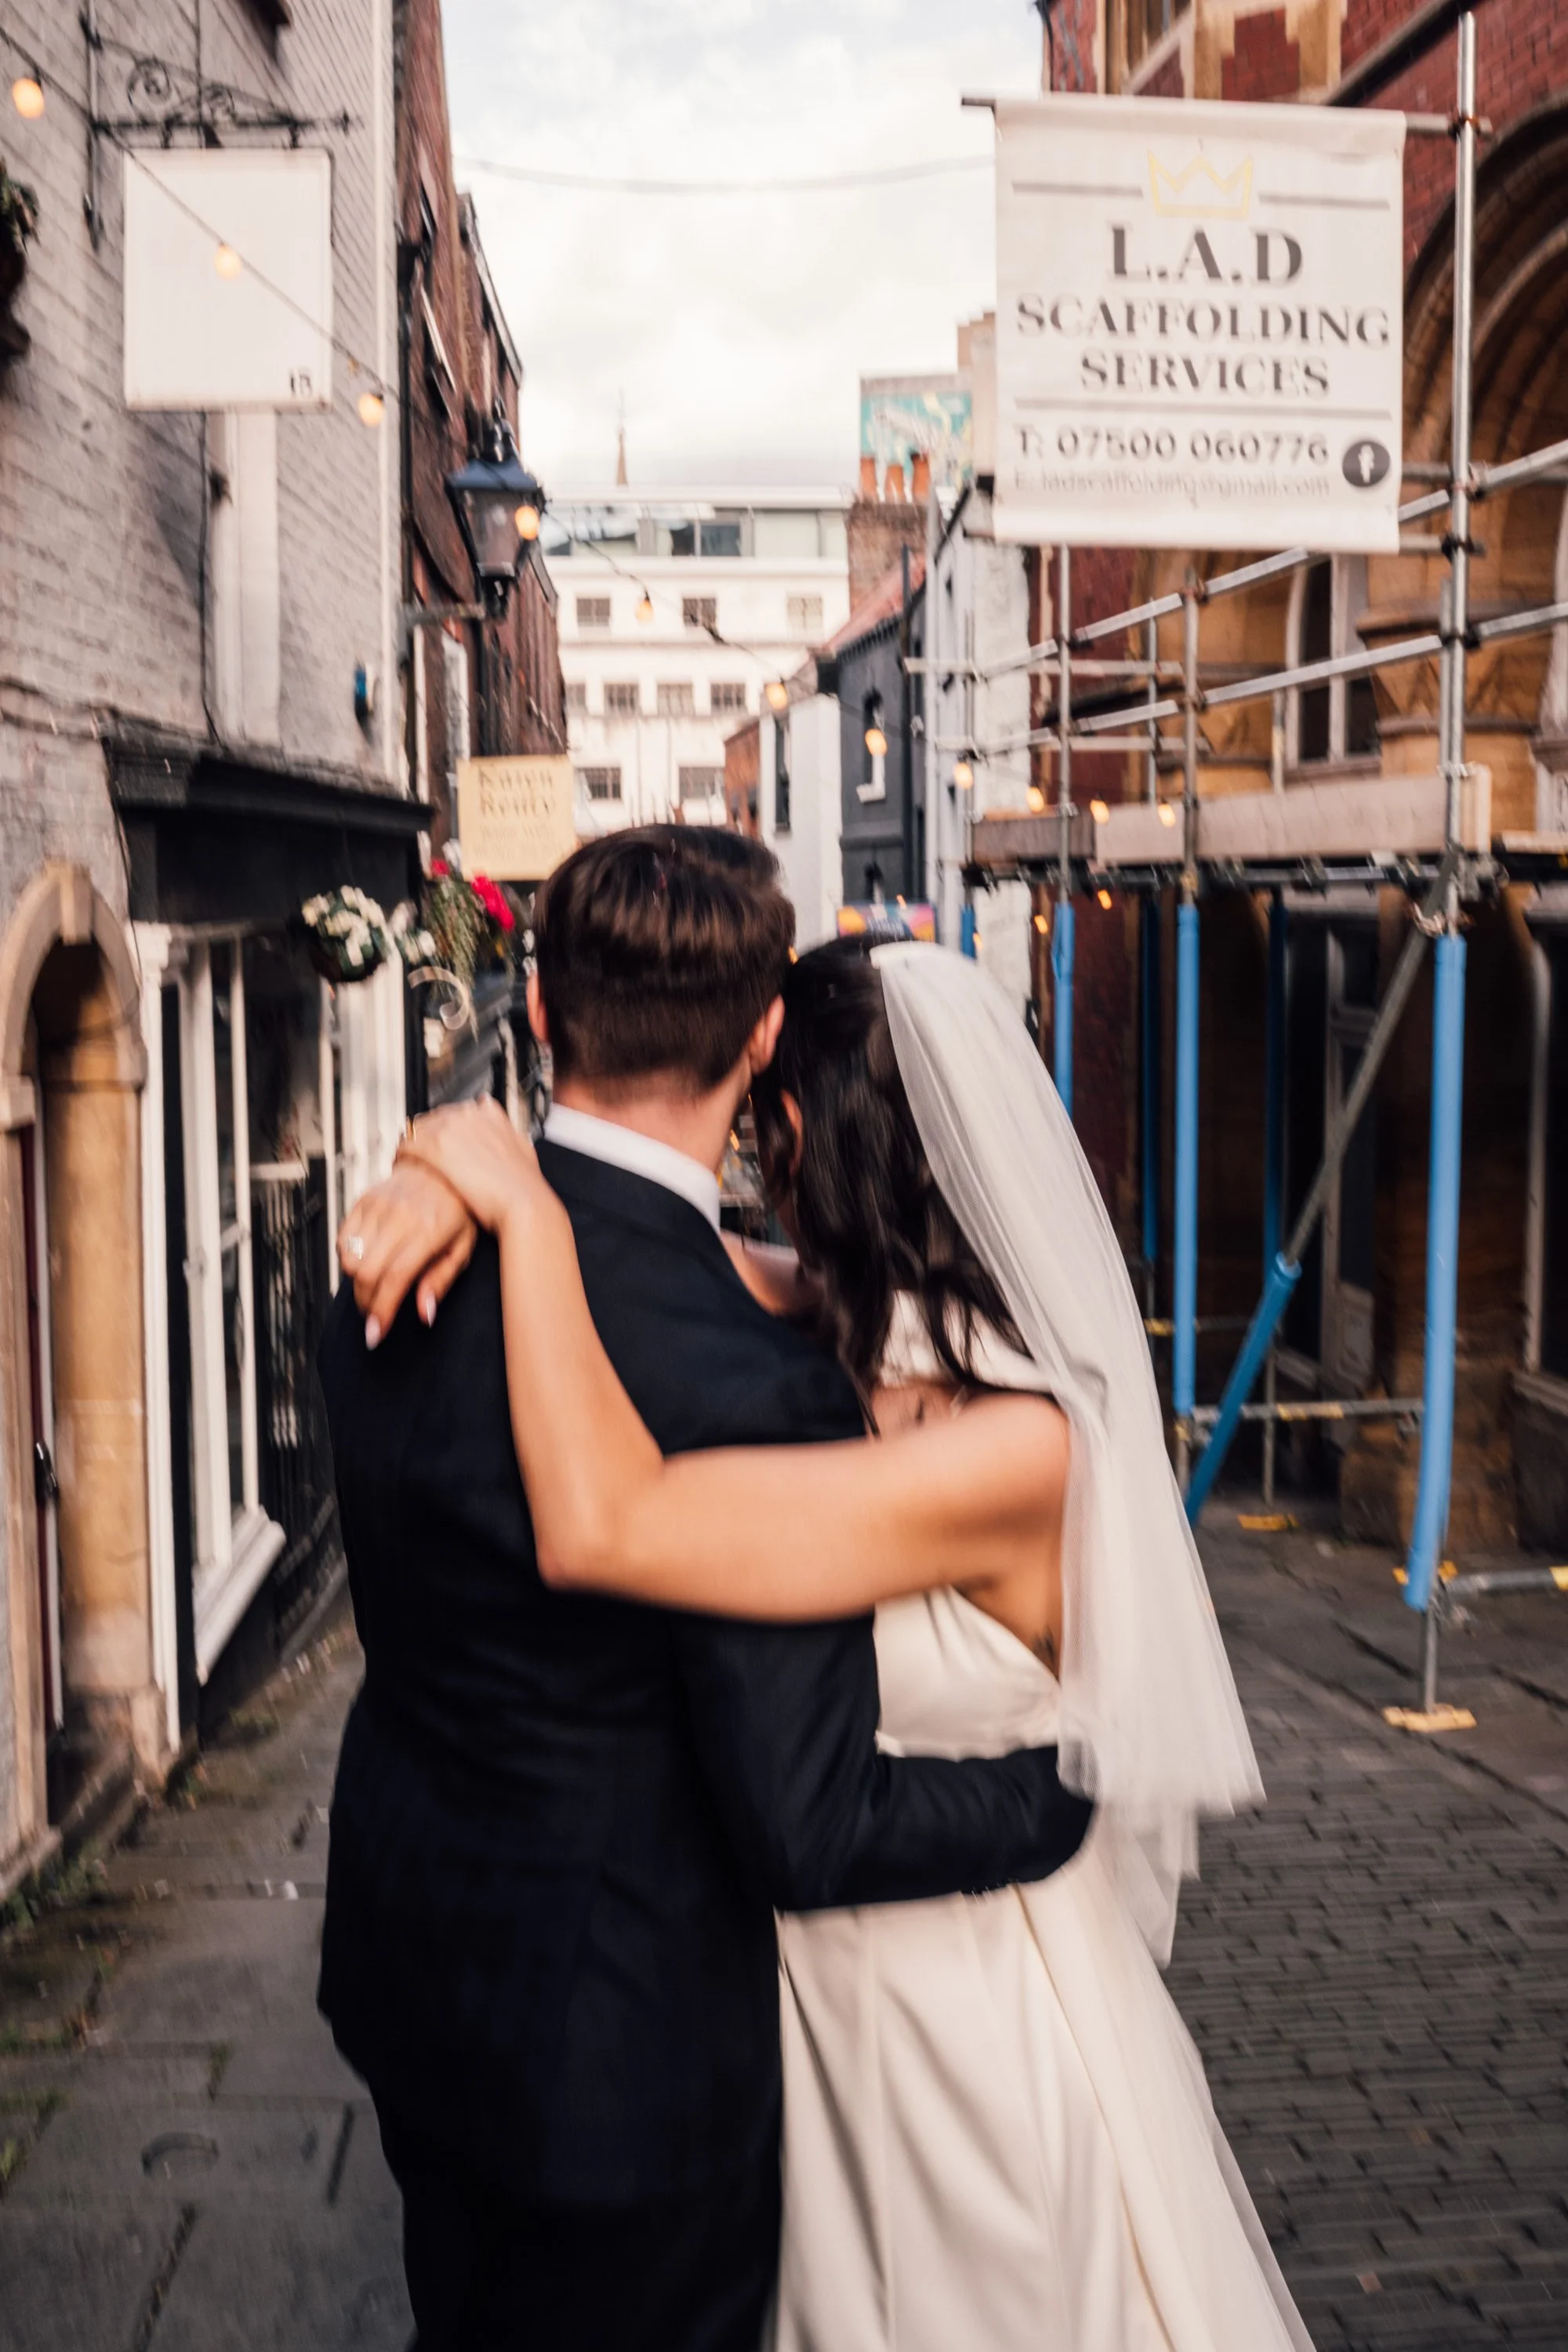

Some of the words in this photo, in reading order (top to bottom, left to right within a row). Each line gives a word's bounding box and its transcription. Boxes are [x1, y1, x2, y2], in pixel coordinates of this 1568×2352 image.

[1107, 223, 1304, 285] L.A.D
[1016, 294, 1391, 350] SCAFFOLDING
[1081, 348, 1330, 397] SERVICES
[1057, 426, 1178, 463] 07500
[1189, 430, 1330, 465] 060776
